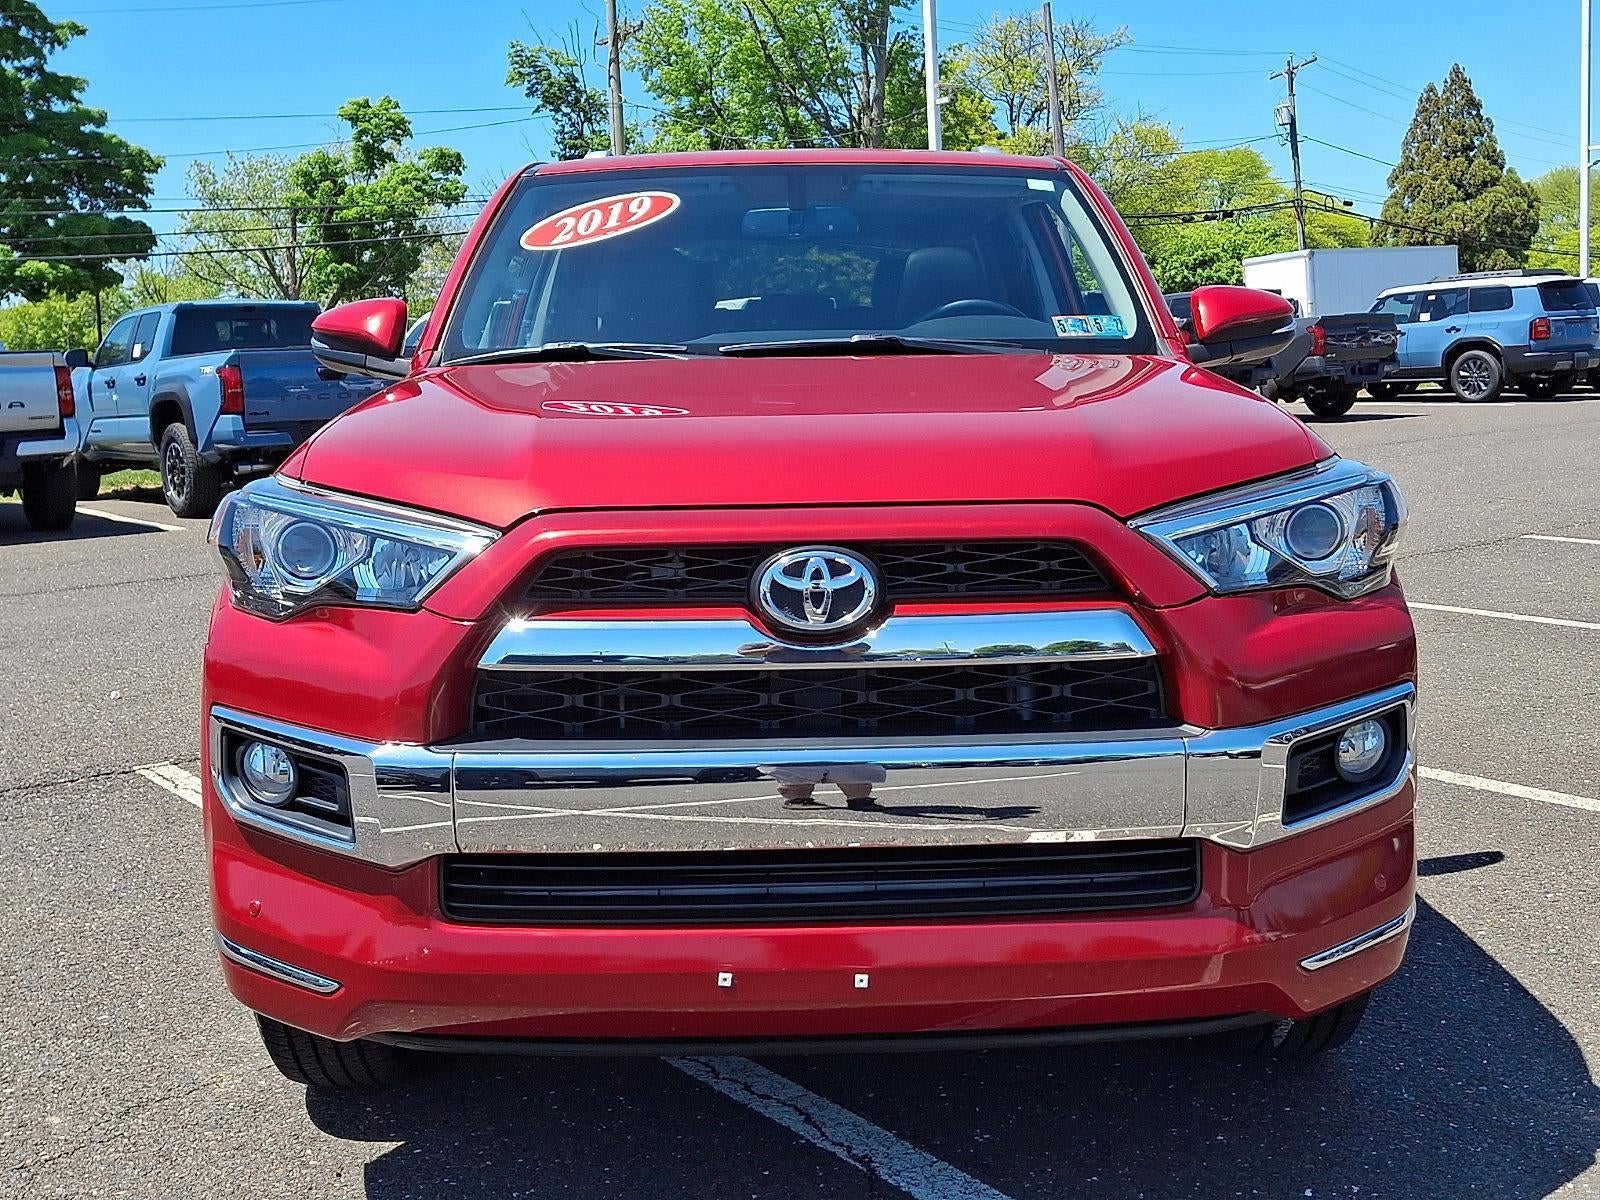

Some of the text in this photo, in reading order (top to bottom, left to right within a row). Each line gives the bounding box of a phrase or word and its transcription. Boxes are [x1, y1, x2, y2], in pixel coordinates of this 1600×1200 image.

[550, 196, 652, 246] 2019
[1057, 319, 1067, 334] 5
[1093, 318, 1104, 333] 5
